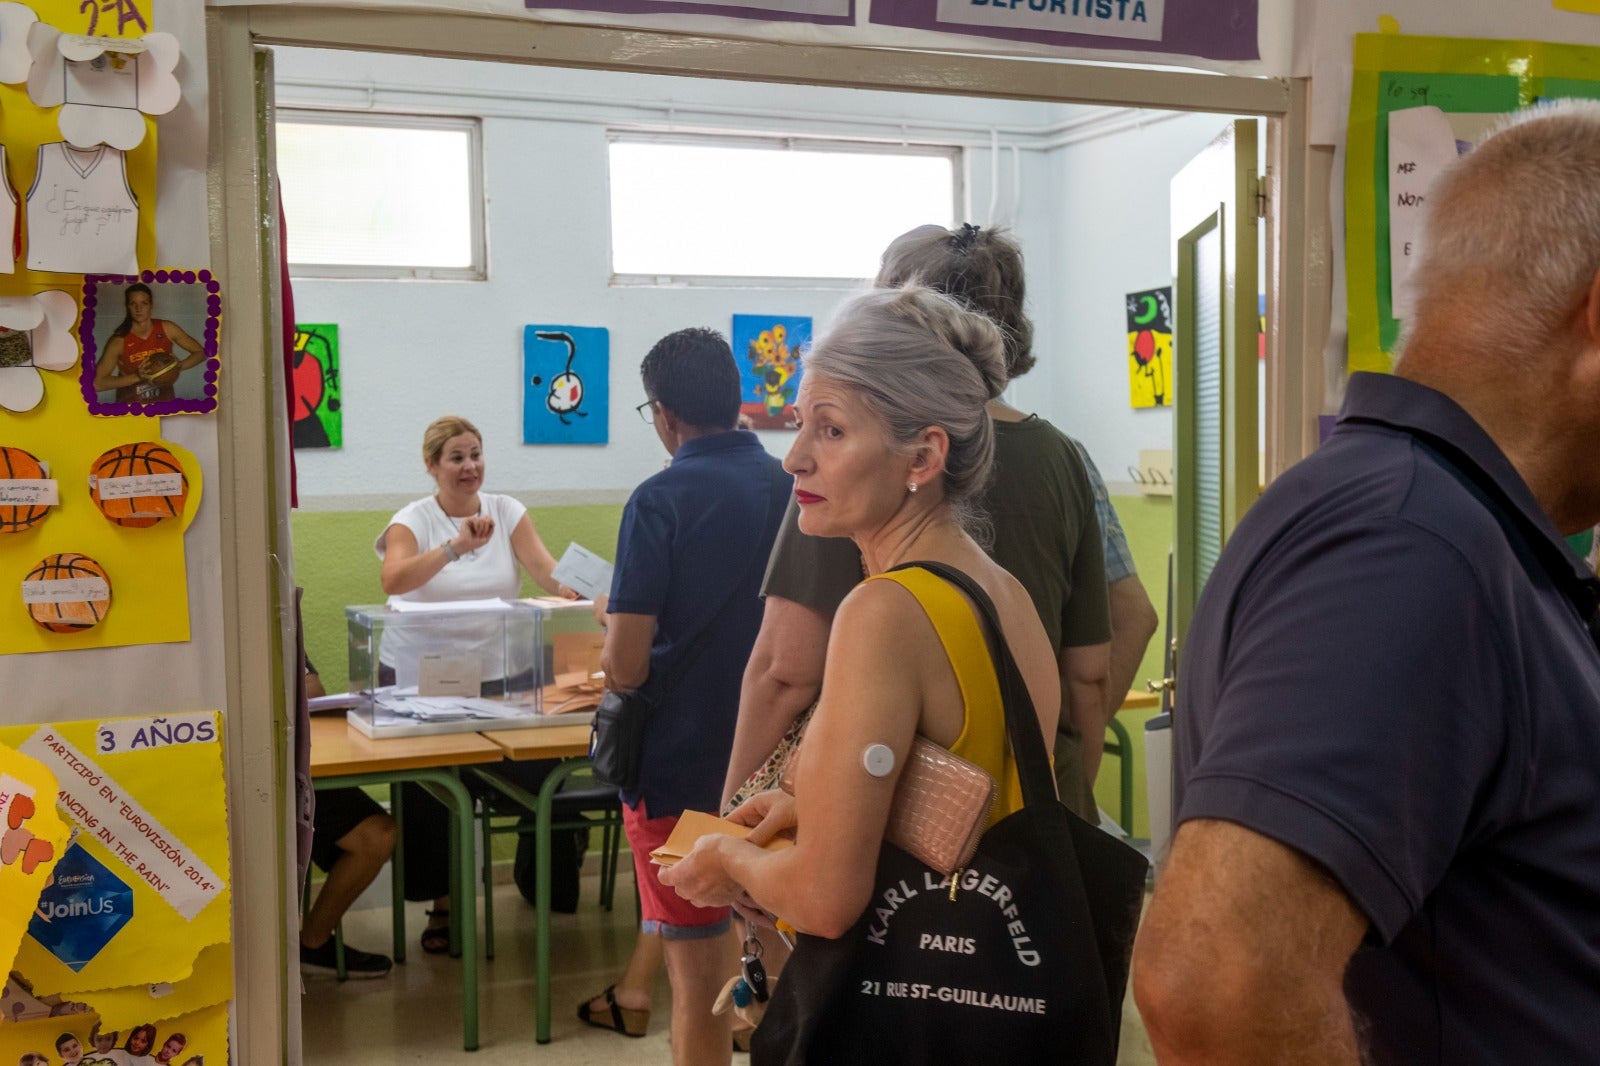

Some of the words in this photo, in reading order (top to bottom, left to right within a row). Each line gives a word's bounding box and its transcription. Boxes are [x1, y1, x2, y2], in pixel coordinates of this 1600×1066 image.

[971, 0, 1147, 22] ORTISTA
[100, 730, 116, 751] 3
[130, 718, 215, 749] AÑOS
[43, 734, 101, 787] PARTICIPÓ
[99, 785, 118, 804] EN
[58, 790, 99, 828] ANCING
[97, 826, 115, 844] IN
[114, 841, 138, 866] THE
[40, 897, 114, 919] #JoinUs
[867, 880, 918, 946] KARL
[919, 933, 976, 955] PARIS
[861, 980, 880, 996] 21
[886, 982, 908, 998] RUE
[910, 983, 1046, 1014] ST-GUILLAUME
